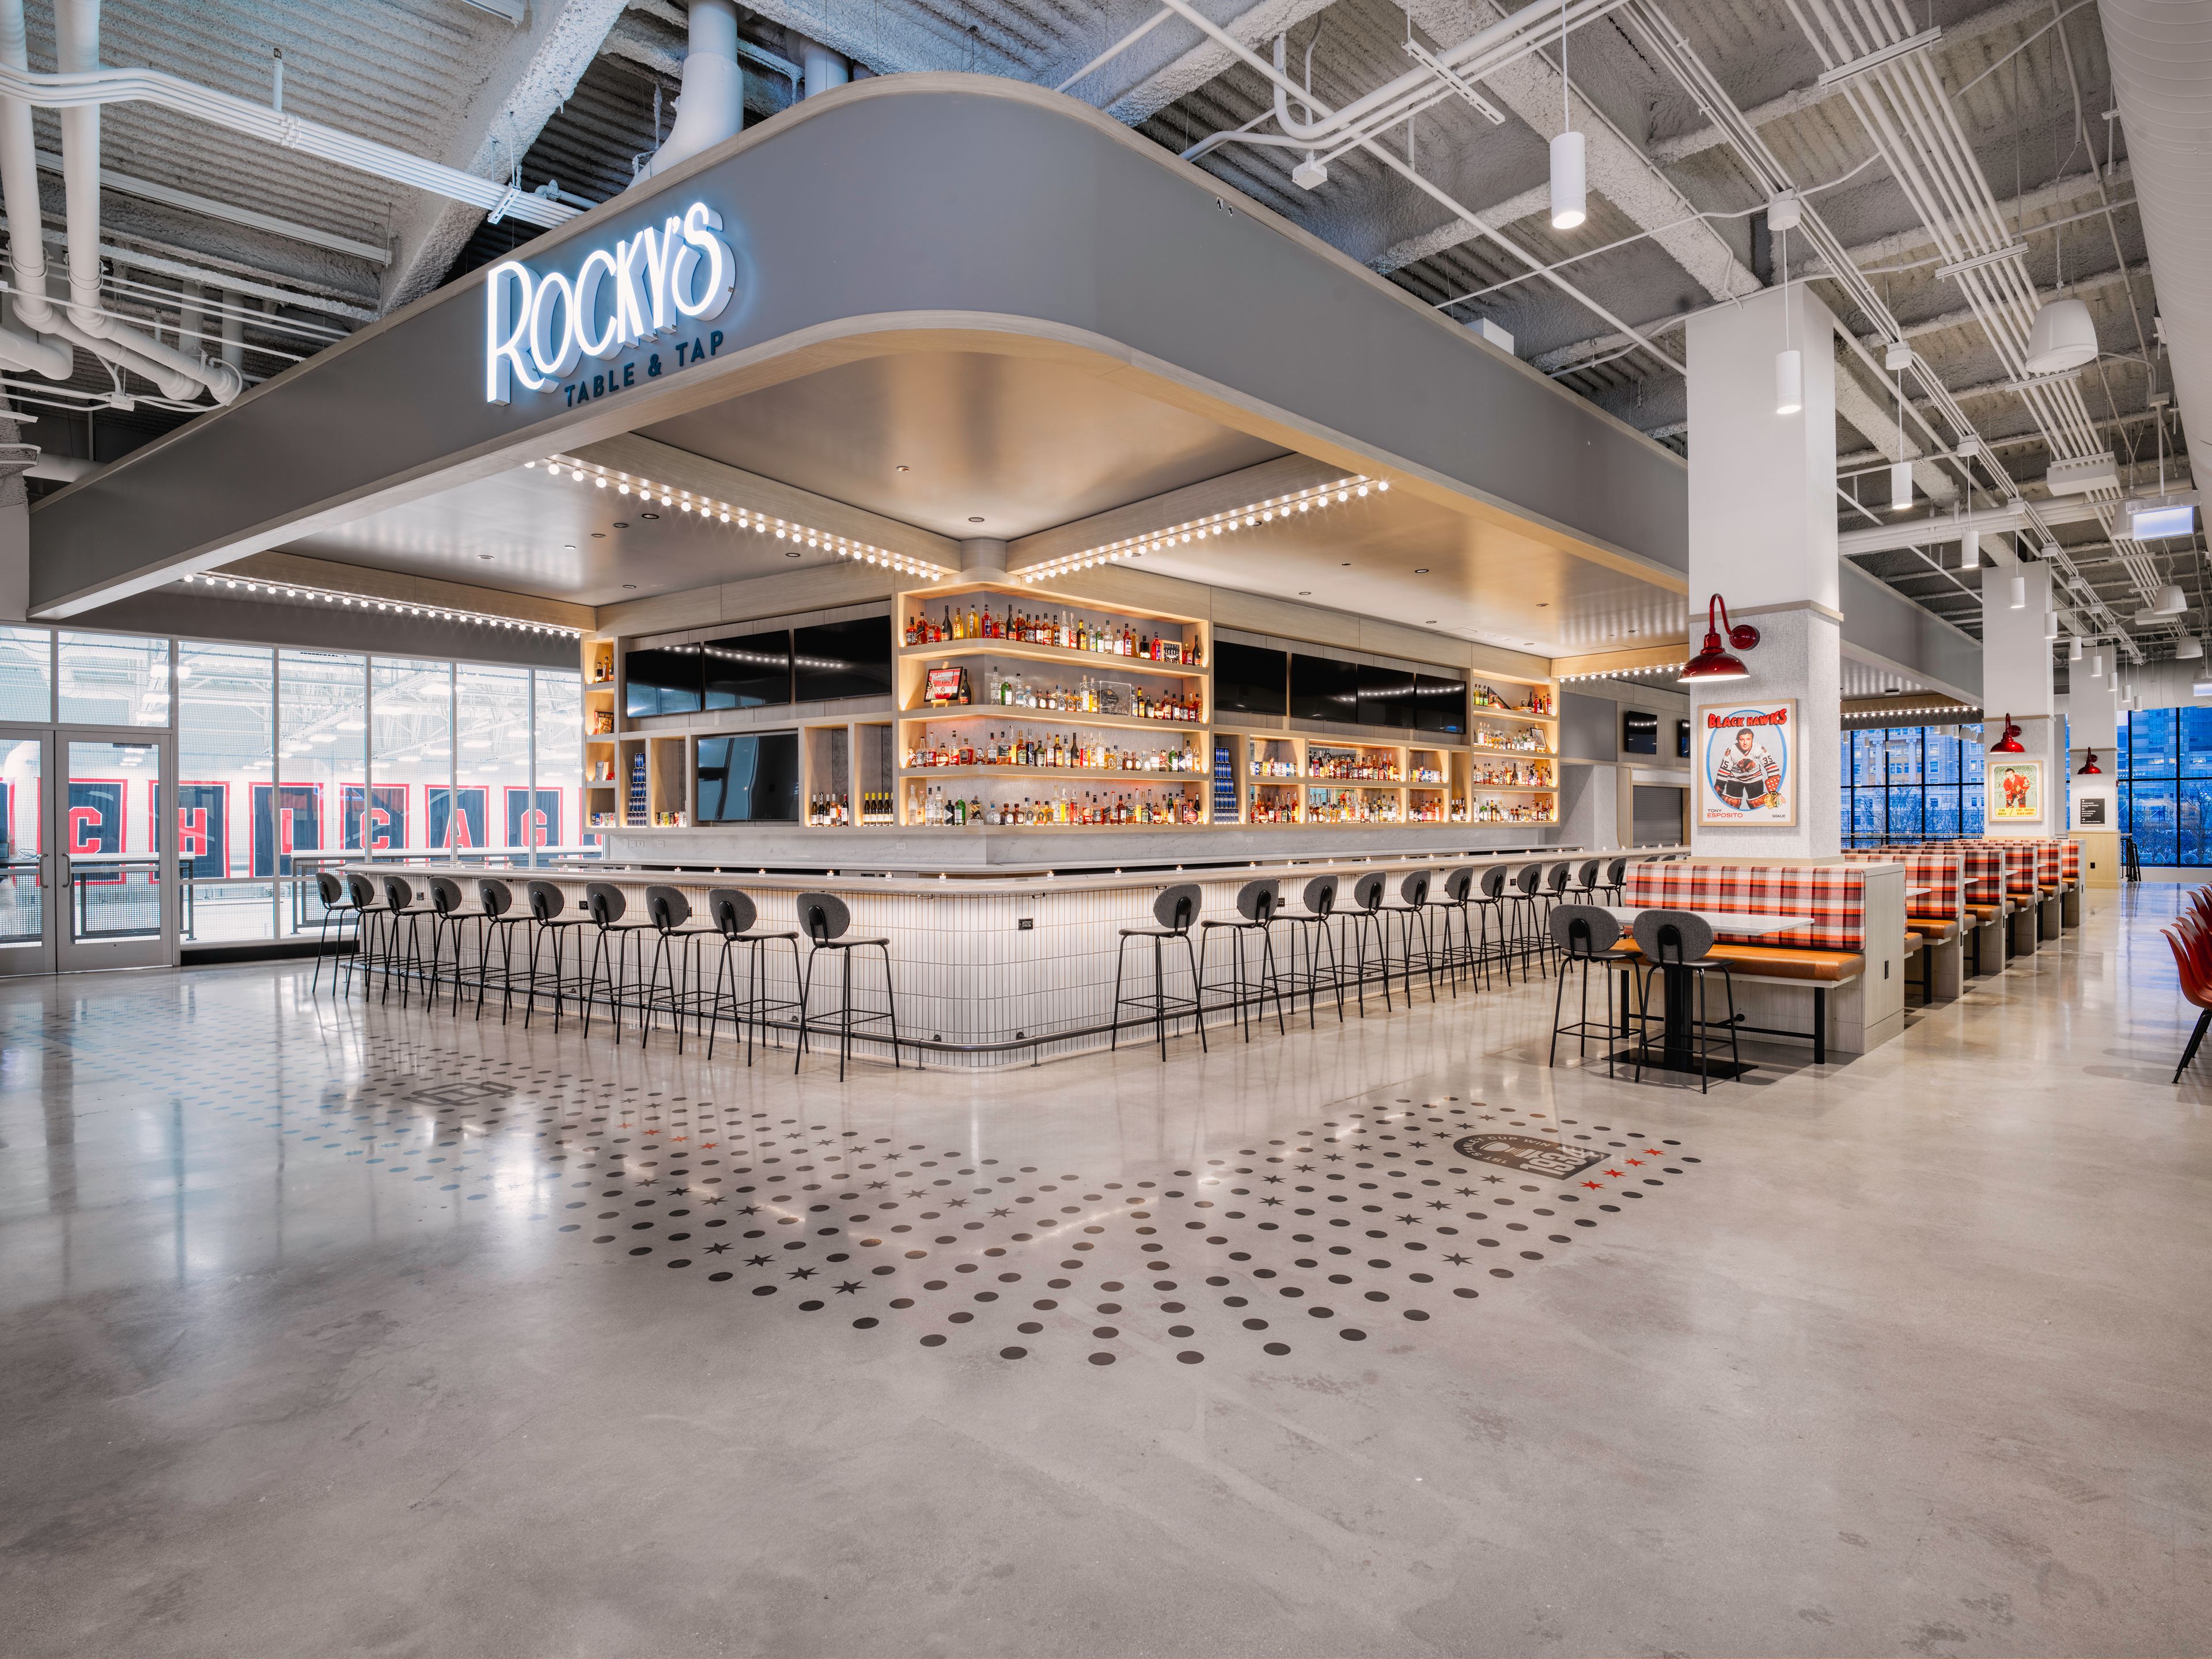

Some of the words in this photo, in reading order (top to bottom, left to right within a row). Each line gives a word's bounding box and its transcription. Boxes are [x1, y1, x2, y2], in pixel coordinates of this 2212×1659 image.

[487, 202, 727, 404] ROCKY'S
[565, 362, 635, 407] TABLE
[648, 354, 662, 377] &
[675, 331, 724, 367] TAP
[1708, 713, 1745, 729] BLACK
[1747, 708, 1787, 727] HAWKS
[1763, 755, 1773, 765] 35
[1463, 1137, 1484, 1157] STANLEY
[1524, 1139, 1551, 1147] WIN
[1483, 1156, 1508, 1164] 1ST
[1520, 1146, 1600, 1176] 1934
